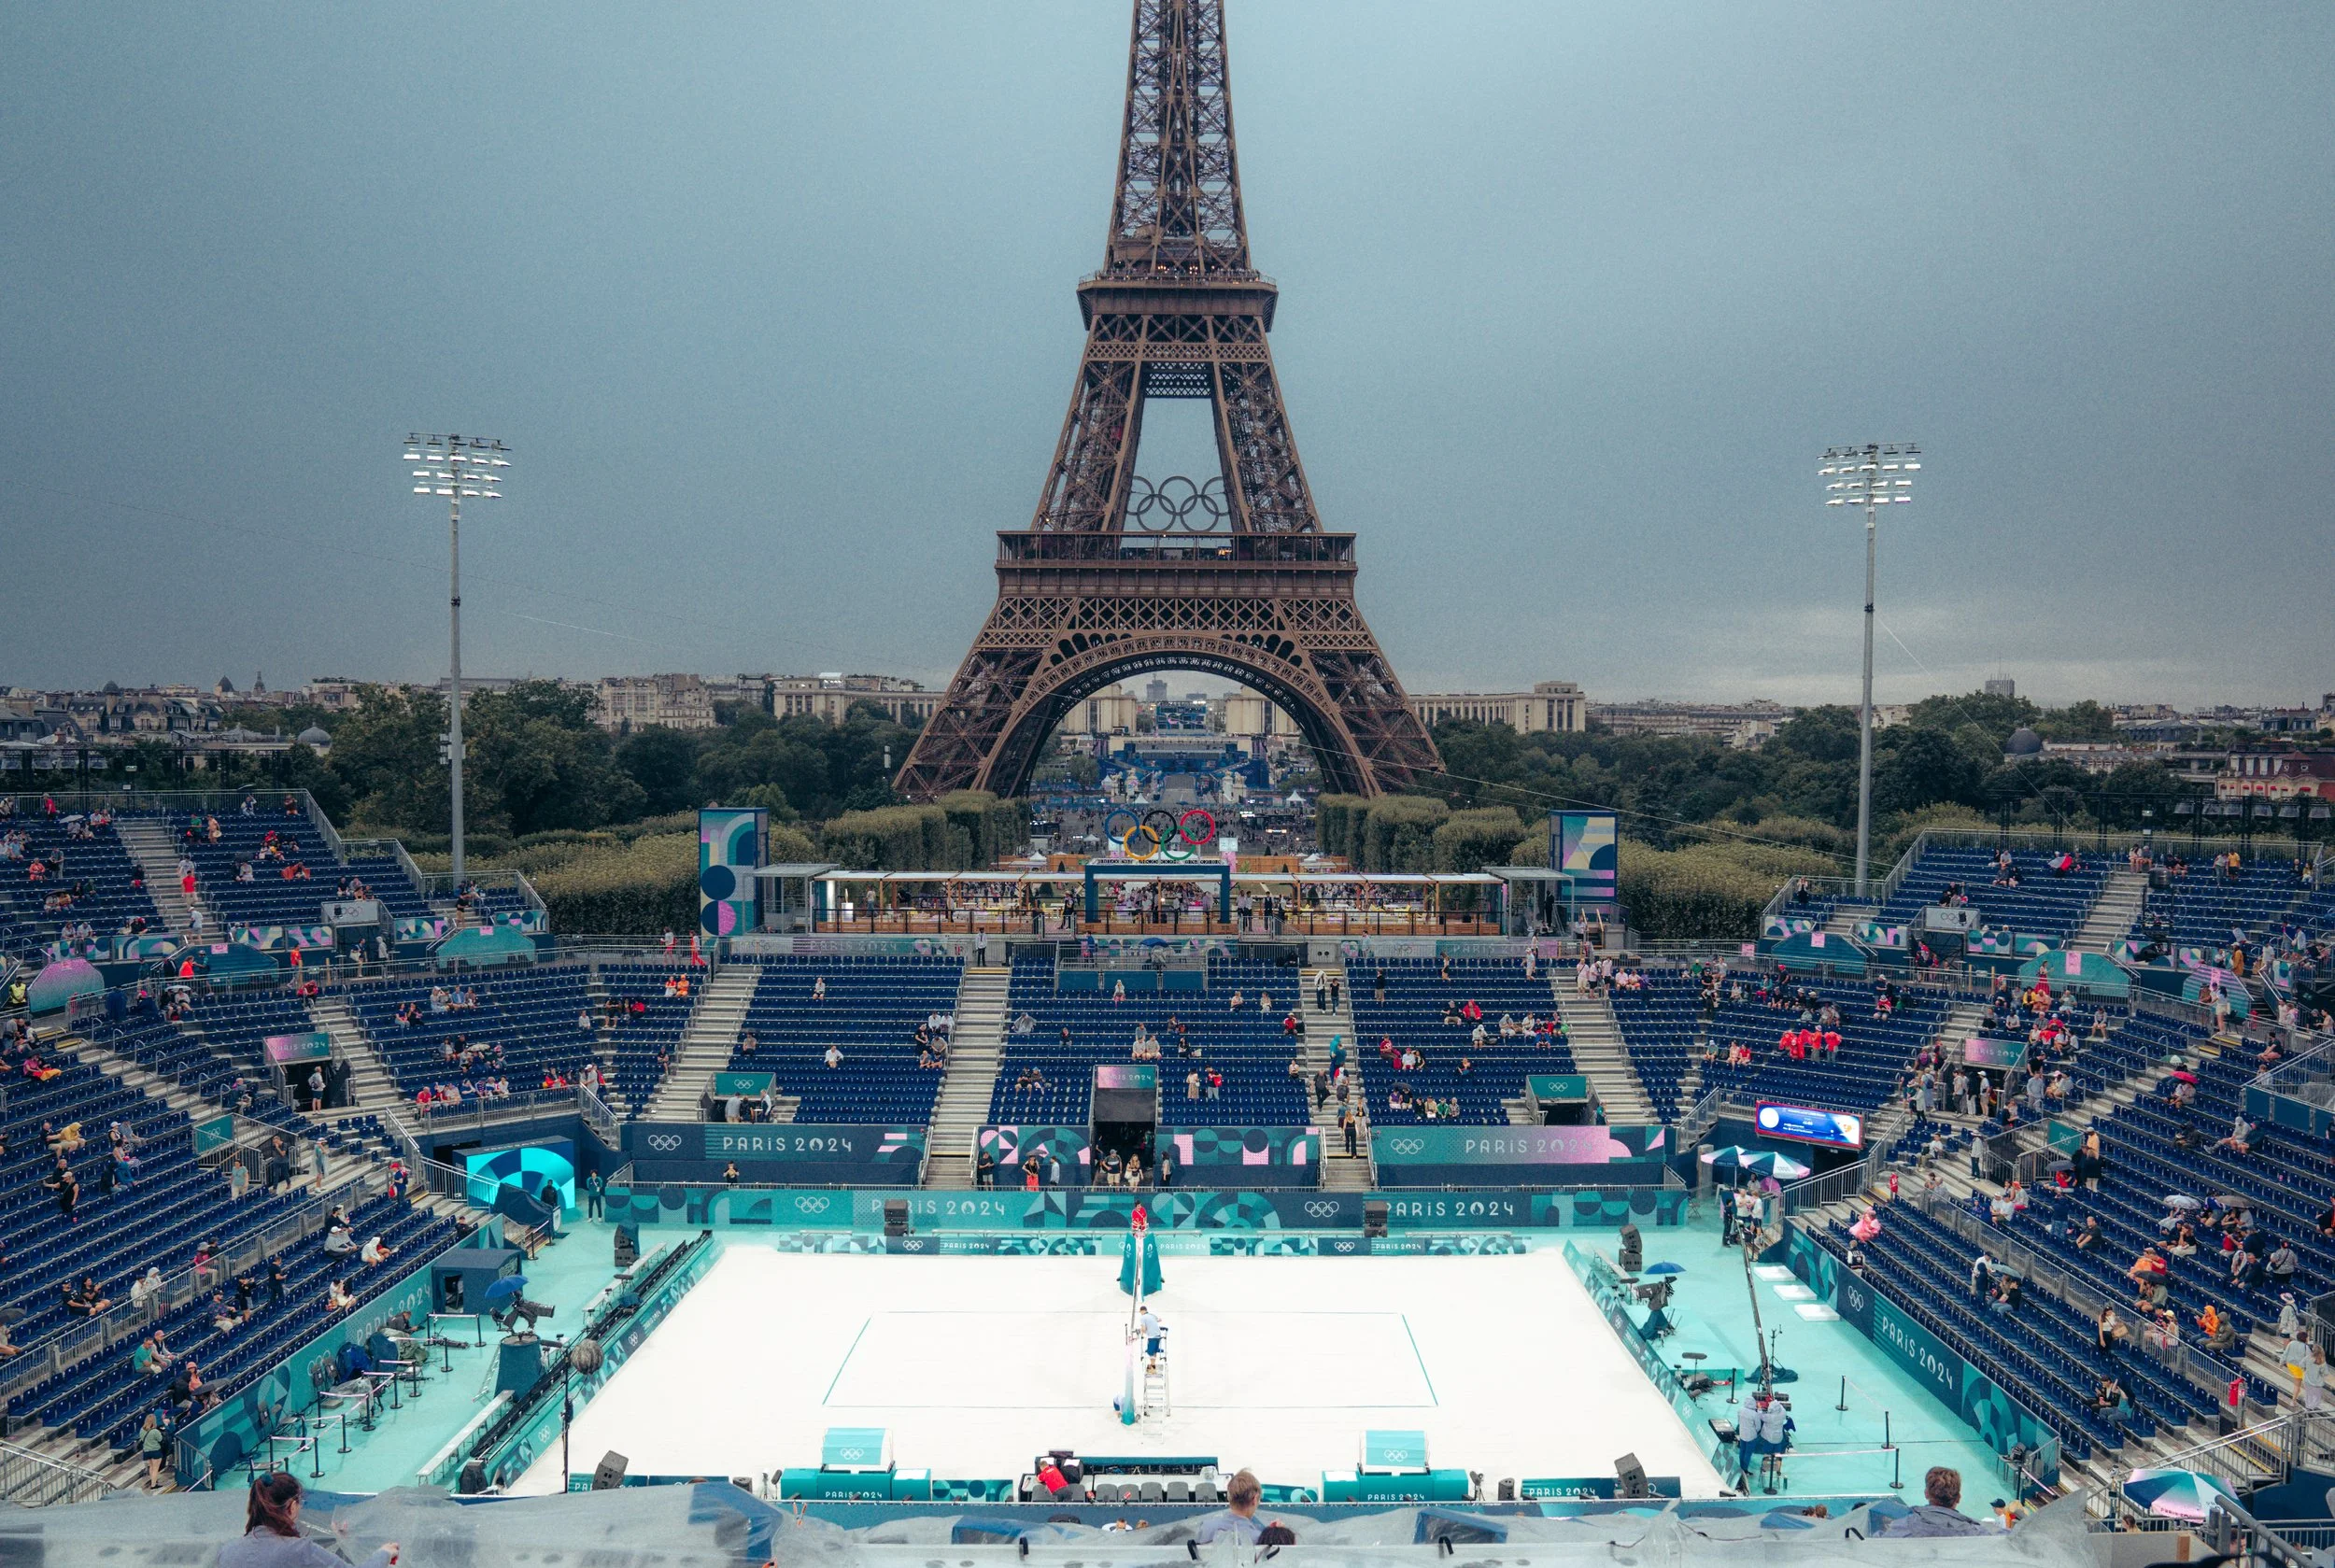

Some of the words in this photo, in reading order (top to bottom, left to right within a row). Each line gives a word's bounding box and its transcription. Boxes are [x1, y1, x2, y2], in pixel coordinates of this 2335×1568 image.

[723, 1137, 785, 1151] PARIS
[795, 1137, 852, 1152] 2024
[1465, 1140, 1527, 1153] PARIS
[1537, 1140, 1592, 1153] 2024
[946, 1201, 1005, 1215] 2024
[1456, 1202, 1513, 1216] 2024
[1883, 1316, 1915, 1358] PARIS
[1920, 1347, 1952, 1389] 2024
[1529, 1488, 1562, 1496] PARIS
[1566, 1487, 1595, 1496] 2024
